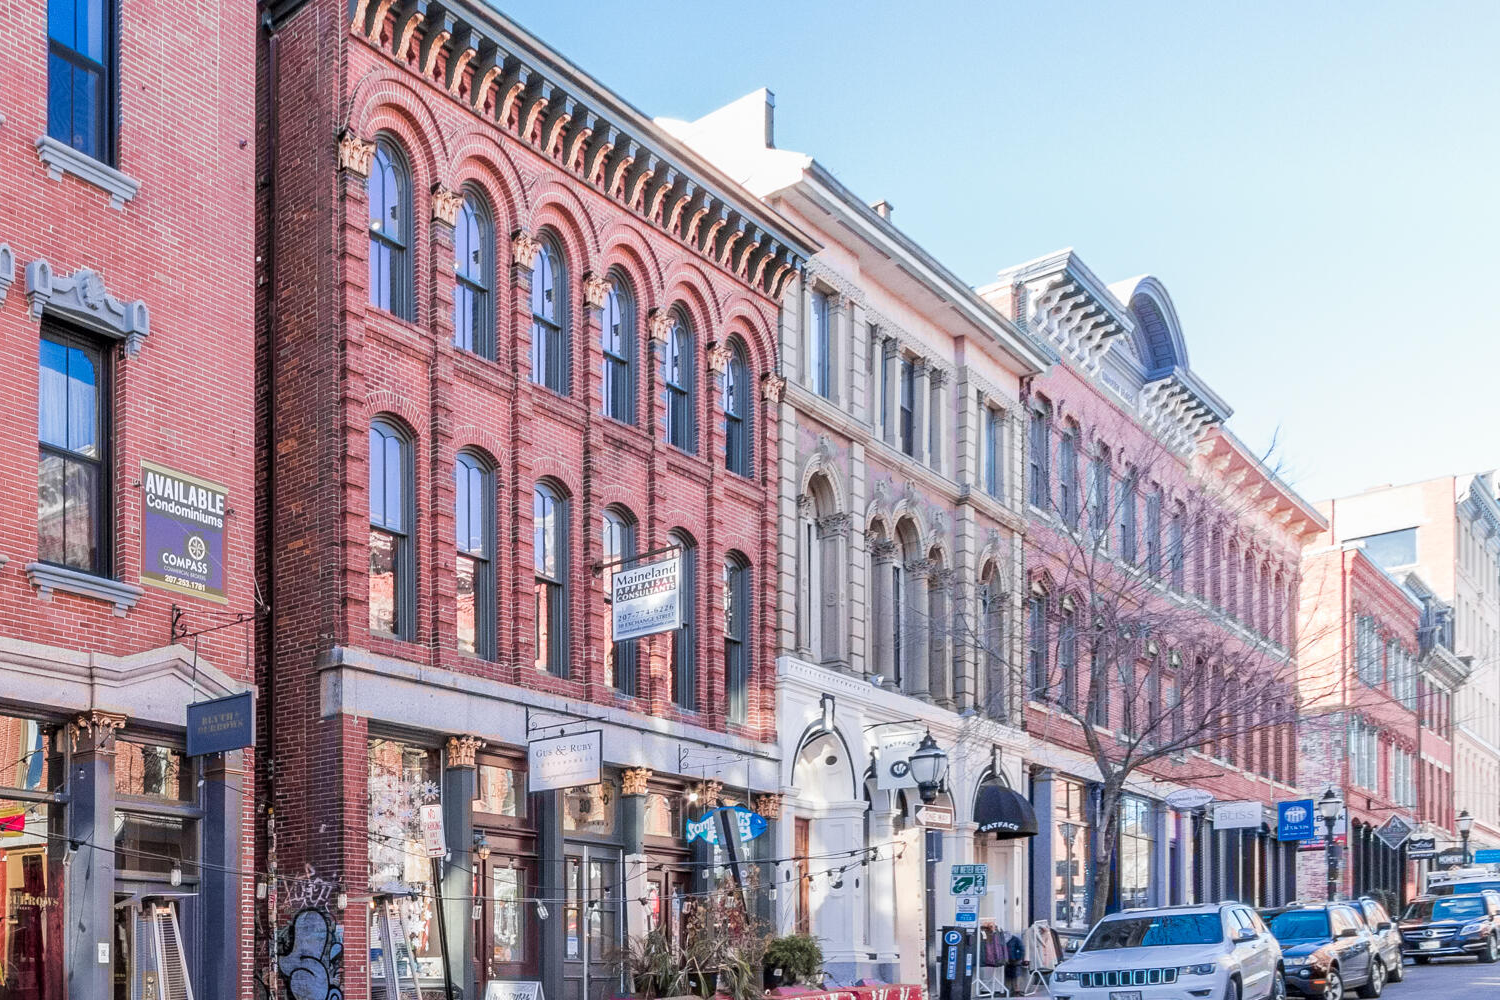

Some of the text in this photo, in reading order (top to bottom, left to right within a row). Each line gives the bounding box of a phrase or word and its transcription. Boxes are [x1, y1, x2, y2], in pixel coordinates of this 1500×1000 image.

[145, 472, 225, 515] AVAILABLE
[146, 493, 224, 528] Condominiums
[162, 552, 208, 574] COMPASS
[616, 562, 676, 587] Maineland
[616, 583, 676, 602] CONSULTANTS
[617, 575, 675, 596] APPRAISAL
[555, 745, 567, 756] &
[570, 743, 593, 753] RUBY
[981, 821, 1019, 832] FATFACE
